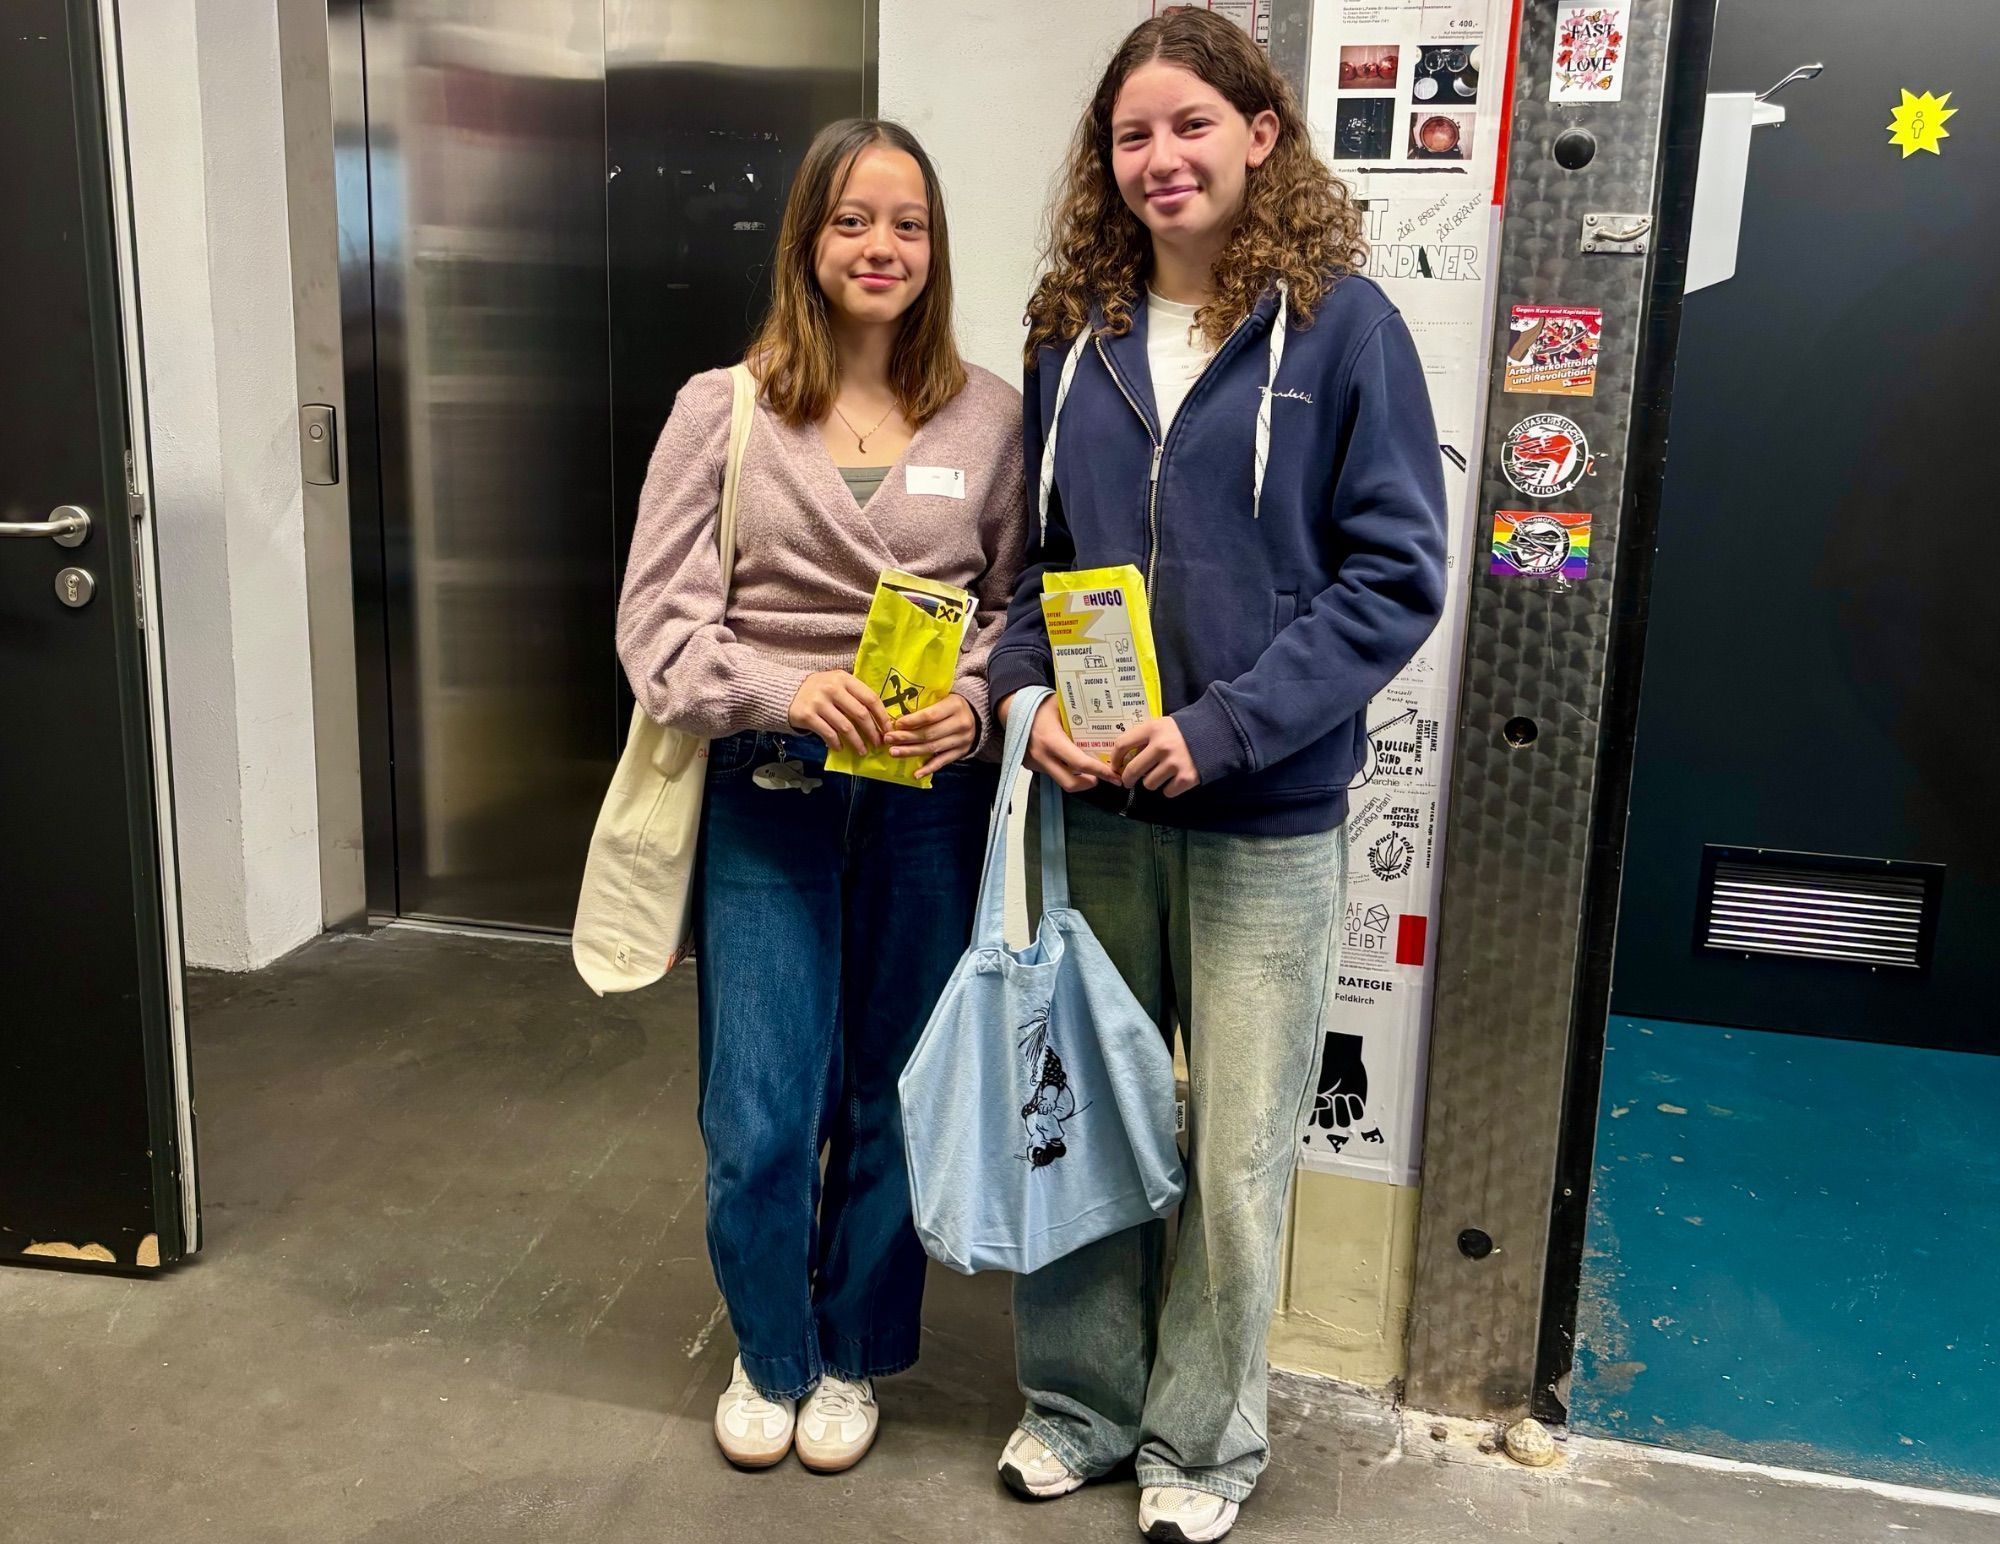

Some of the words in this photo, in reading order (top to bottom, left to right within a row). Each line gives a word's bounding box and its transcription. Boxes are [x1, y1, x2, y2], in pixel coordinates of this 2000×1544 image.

[1570, 24, 1616, 39] FAST
[1567, 57, 1613, 72] LOVE
[1369, 244, 1481, 280] INDIANER
[1509, 359, 1593, 376] Arbeiterkontrolle
[1512, 375, 1532, 385] und
[1534, 367, 1591, 382] Revolution!
[1521, 483, 1561, 495] AKTION
[1090, 589, 1122, 606] HUGO
[1423, 719, 1431, 739] STATT
[1430, 720, 1439, 752] MILITANZ
[1376, 740, 1415, 753] BULLEN
[1414, 719, 1424, 762] ROSENKRANZ
[1379, 752, 1401, 765] SIND
[1376, 765, 1423, 775] NULLEN
[1383, 813, 1418, 821] macht
[1391, 806, 1419, 814] grass
[1391, 820, 1420, 829] spass
[1338, 976, 1393, 992] RATEGIE
[1334, 993, 1375, 1005] Feldkirch
